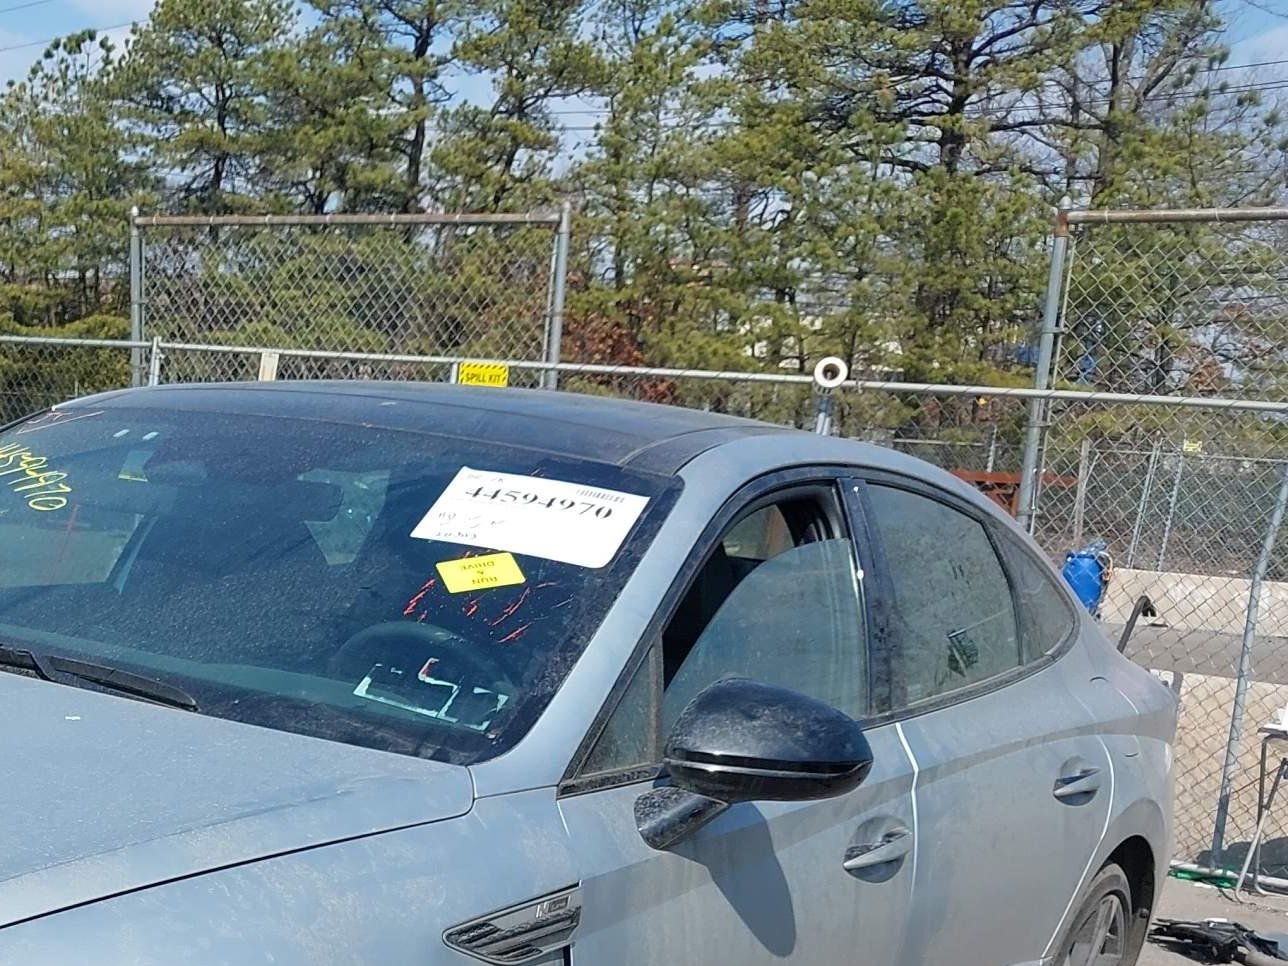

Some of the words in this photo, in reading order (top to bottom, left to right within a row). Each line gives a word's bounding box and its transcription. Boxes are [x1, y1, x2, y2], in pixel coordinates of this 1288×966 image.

[465, 372, 486, 383] SPILL
[488, 374, 501, 384] KIT
[465, 485, 613, 520] 44594970
